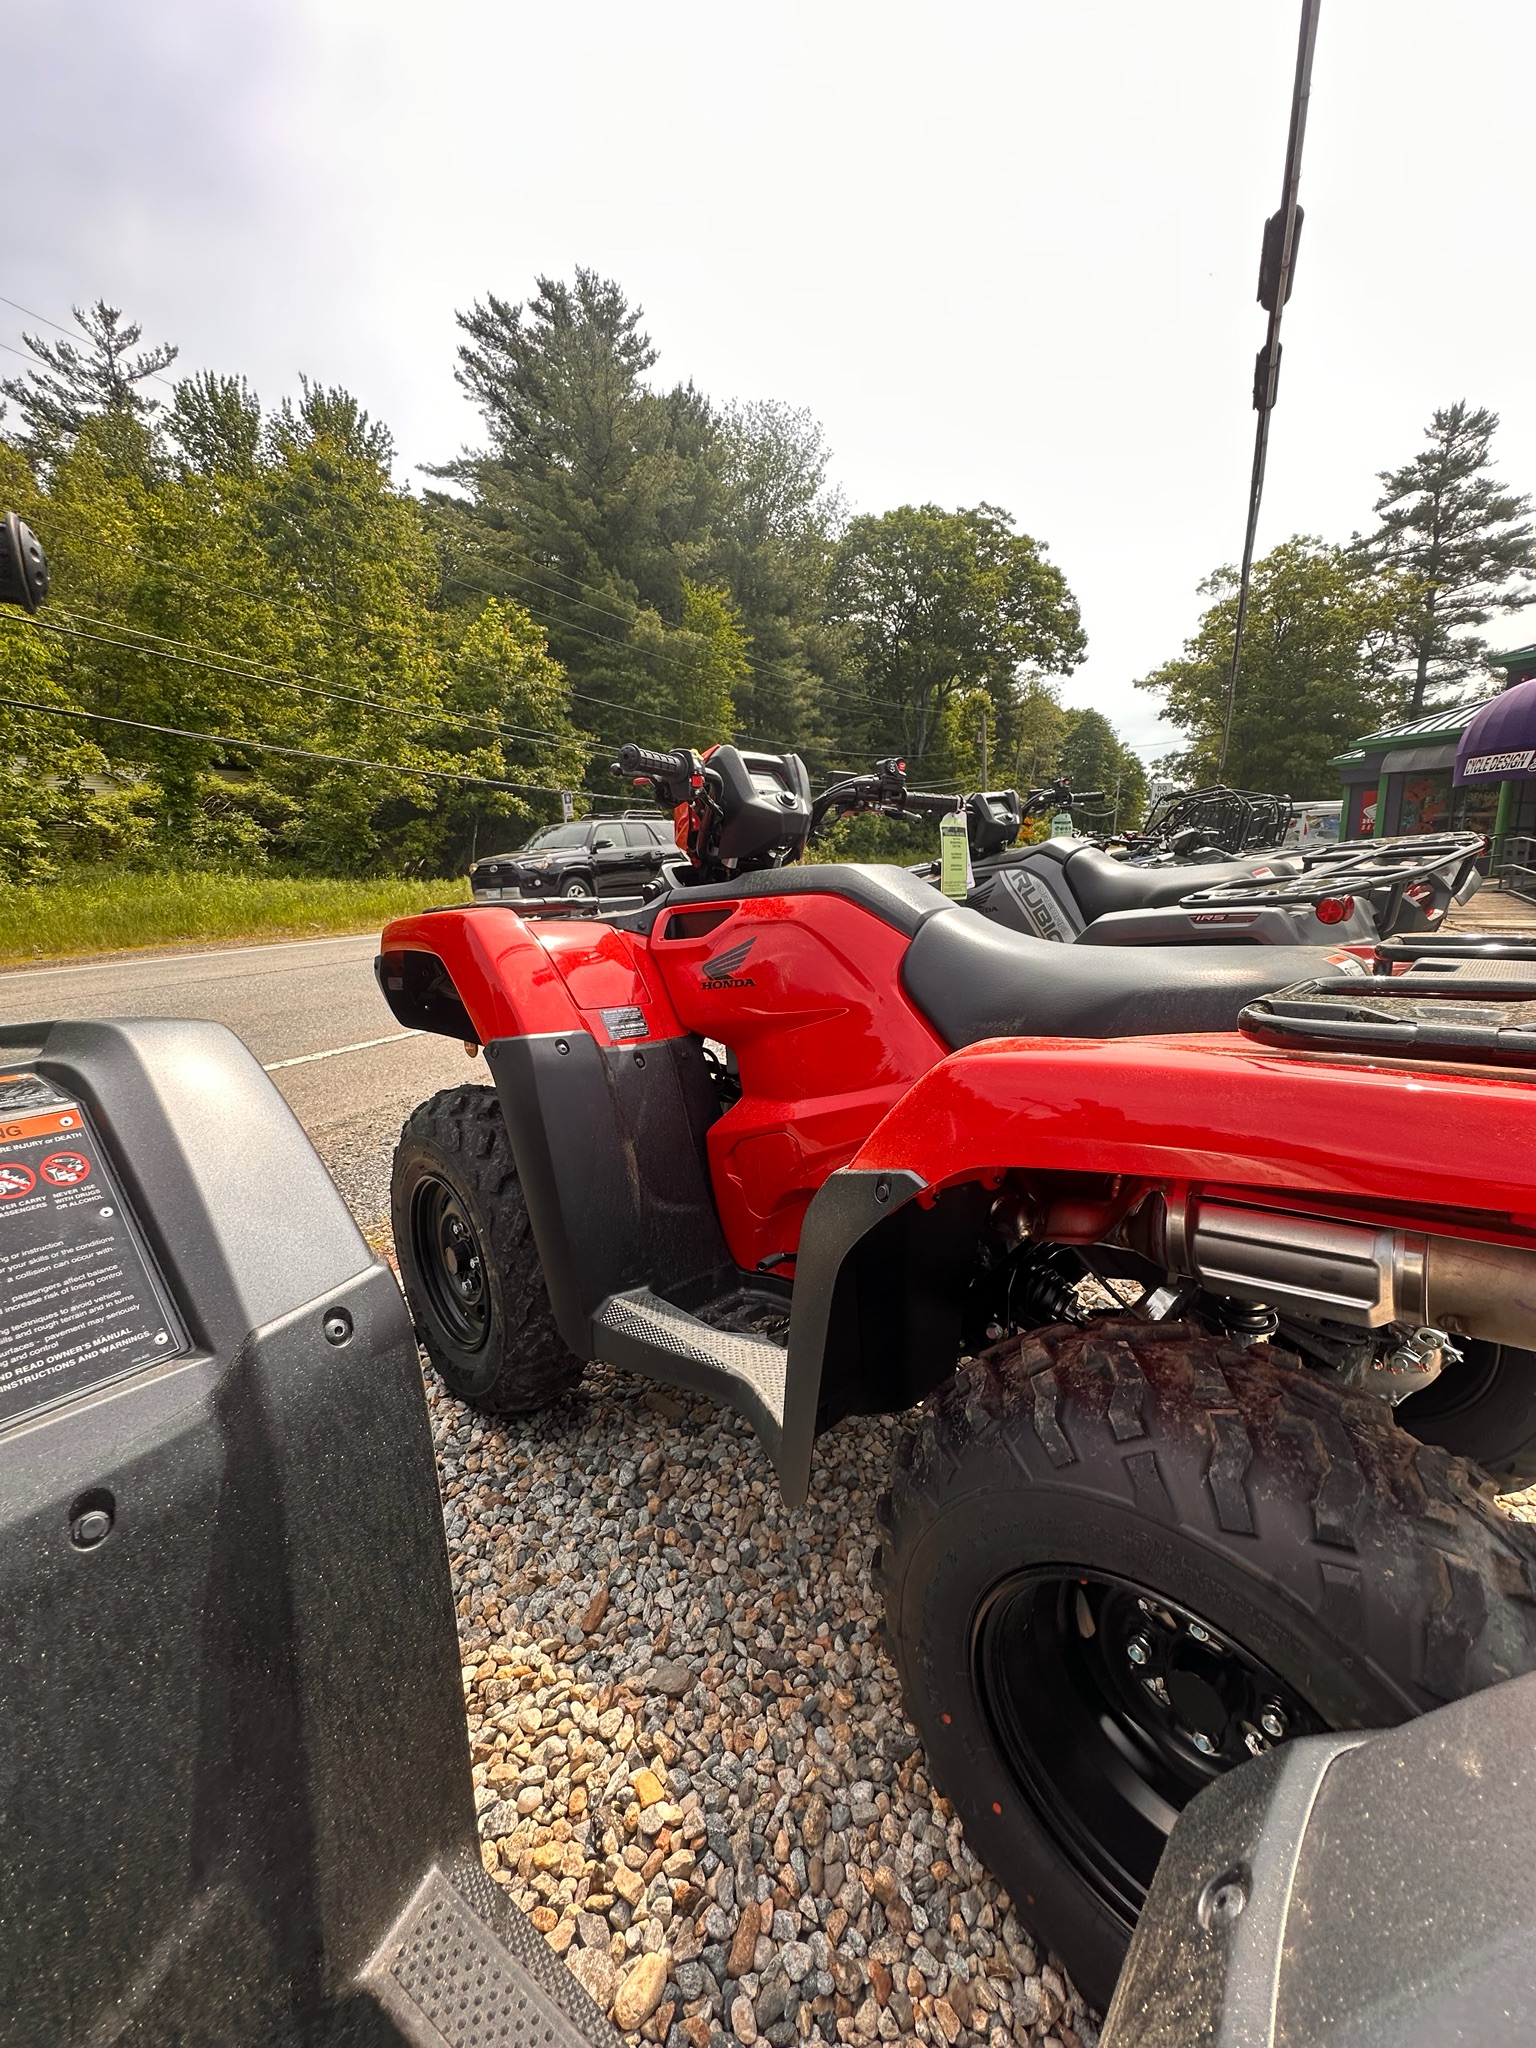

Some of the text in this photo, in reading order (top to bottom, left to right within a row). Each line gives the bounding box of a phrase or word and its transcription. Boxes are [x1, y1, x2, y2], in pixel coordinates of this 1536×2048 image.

[1465, 753, 1530, 774] CYCLE DESIGN
[701, 978, 757, 990] HONDA
[13, 1139, 44, 1150] INJURY
[54, 1132, 83, 1142] DEATH
[18, 1195, 47, 1207] CARRY
[52, 1183, 97, 1198] NEVER USE
[54, 1188, 102, 1204] WITH DRUGS
[55, 1194, 105, 1210] OR ALCOHOL
[7, 1261, 27, 1272] your
[28, 1254, 50, 1265] skills
[50, 1251, 60, 1259] or
[60, 1247, 74, 1255] the
[75, 1236, 115, 1252] conditions
[10, 1252, 20, 1260] or
[21, 1240, 64, 1257] instruction
[15, 1265, 52, 1280] collision
[53, 1260, 70, 1269] can
[70, 1252, 94, 1264] occur
[95, 1246, 114, 1256] with
[4, 1296, 43, 1313] increase
[43, 1291, 60, 1301] risk
[70, 1280, 96, 1292] losing
[96, 1269, 124, 1284] control
[11, 1264, 119, 1303] passengers affect balance
[10, 1311, 59, 1332] techniques
[70, 1299, 93, 1312] avoid
[93, 1289, 122, 1303] vehicle
[14, 1328, 33, 1340] and
[33, 1319, 60, 1333] rough
[59, 1310, 88, 1324] terrain
[88, 1303, 105, 1314] and
[114, 1294, 135, 1305] turns
[44, 1322, 87, 1344] pavement
[87, 1316, 105, 1327] may
[105, 1303, 140, 1320] seriously
[0, 1330, 153, 1393] INSTRUCTIONS AND WARNINGS.
[10, 1351, 28, 1363] and
[29, 1340, 60, 1356] control
[14, 1359, 45, 1375] READ
[46, 1342, 92, 1364] OWNER'S
[92, 1327, 133, 1347] MANUAL
